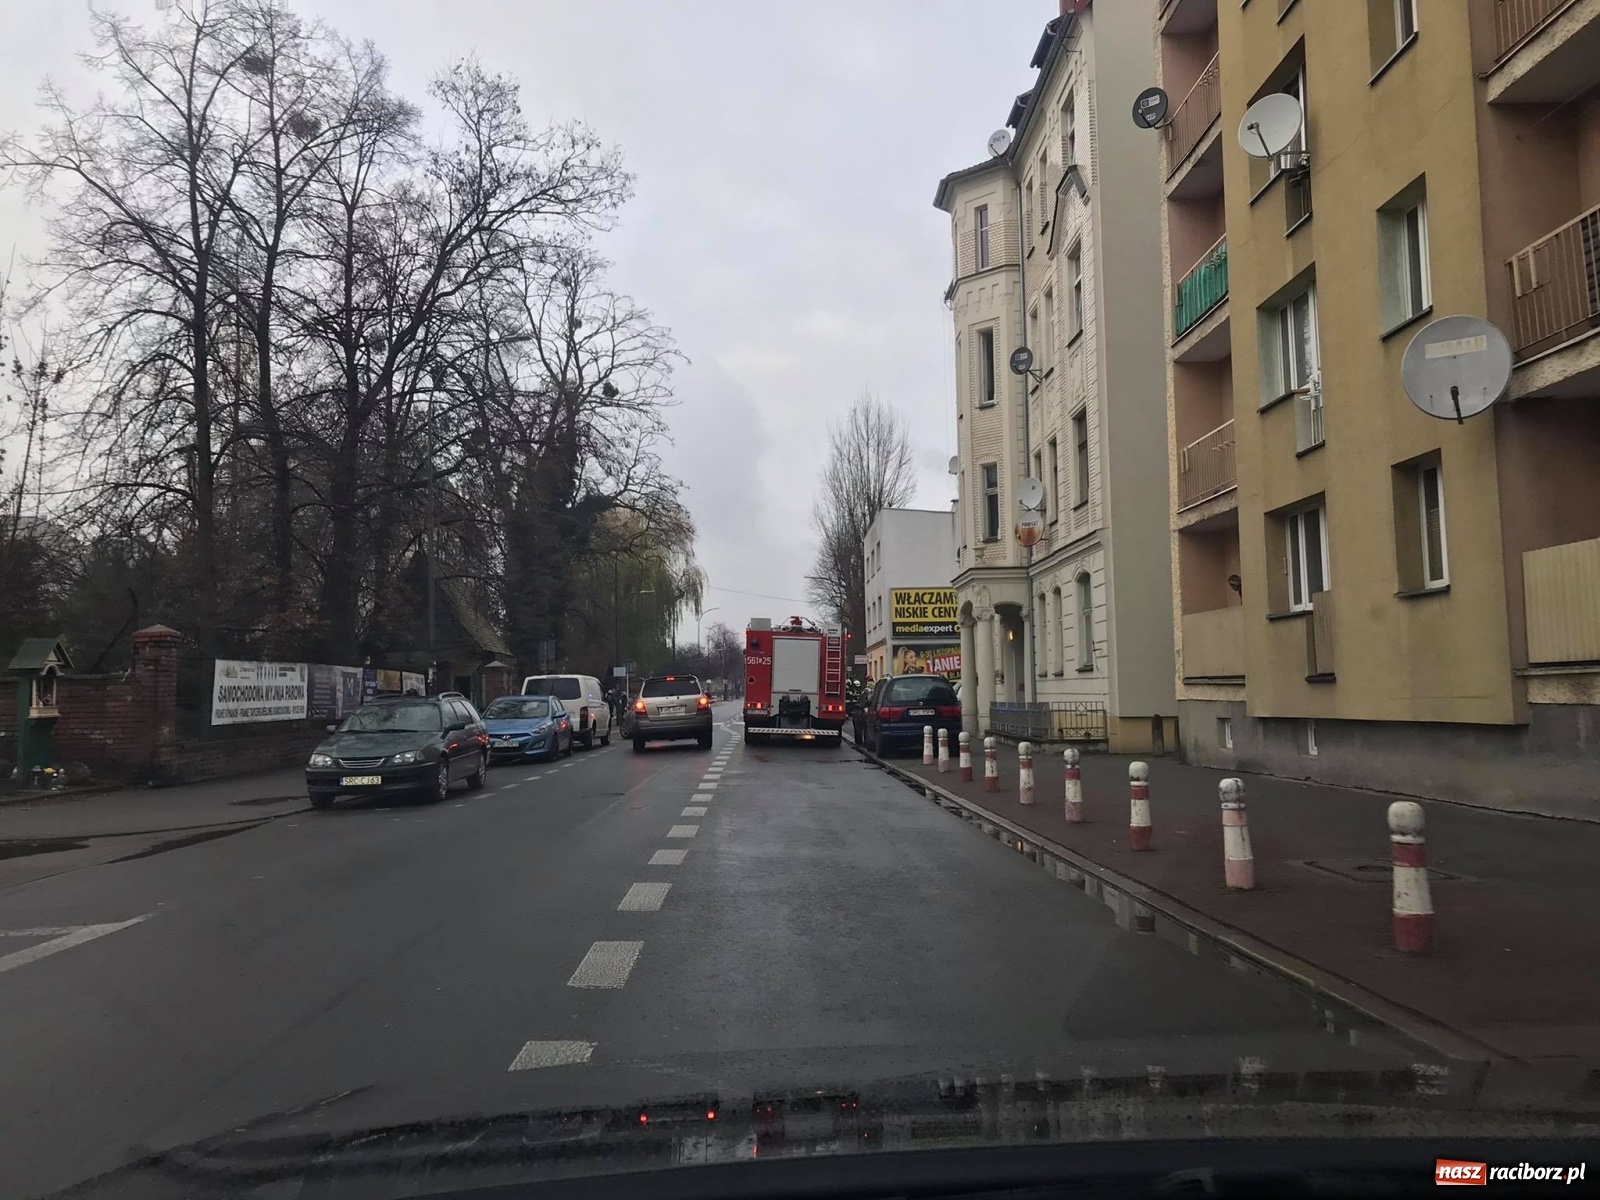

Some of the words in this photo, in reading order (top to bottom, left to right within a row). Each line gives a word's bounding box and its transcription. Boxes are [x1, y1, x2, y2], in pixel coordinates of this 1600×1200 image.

[894, 606, 929, 619] NISKIE
[931, 606, 958, 619] CENY
[895, 624, 953, 634] mediaexpert
[217, 685, 264, 703] SAMOCHODOWA
[285, 685, 305, 701] PAROWA
